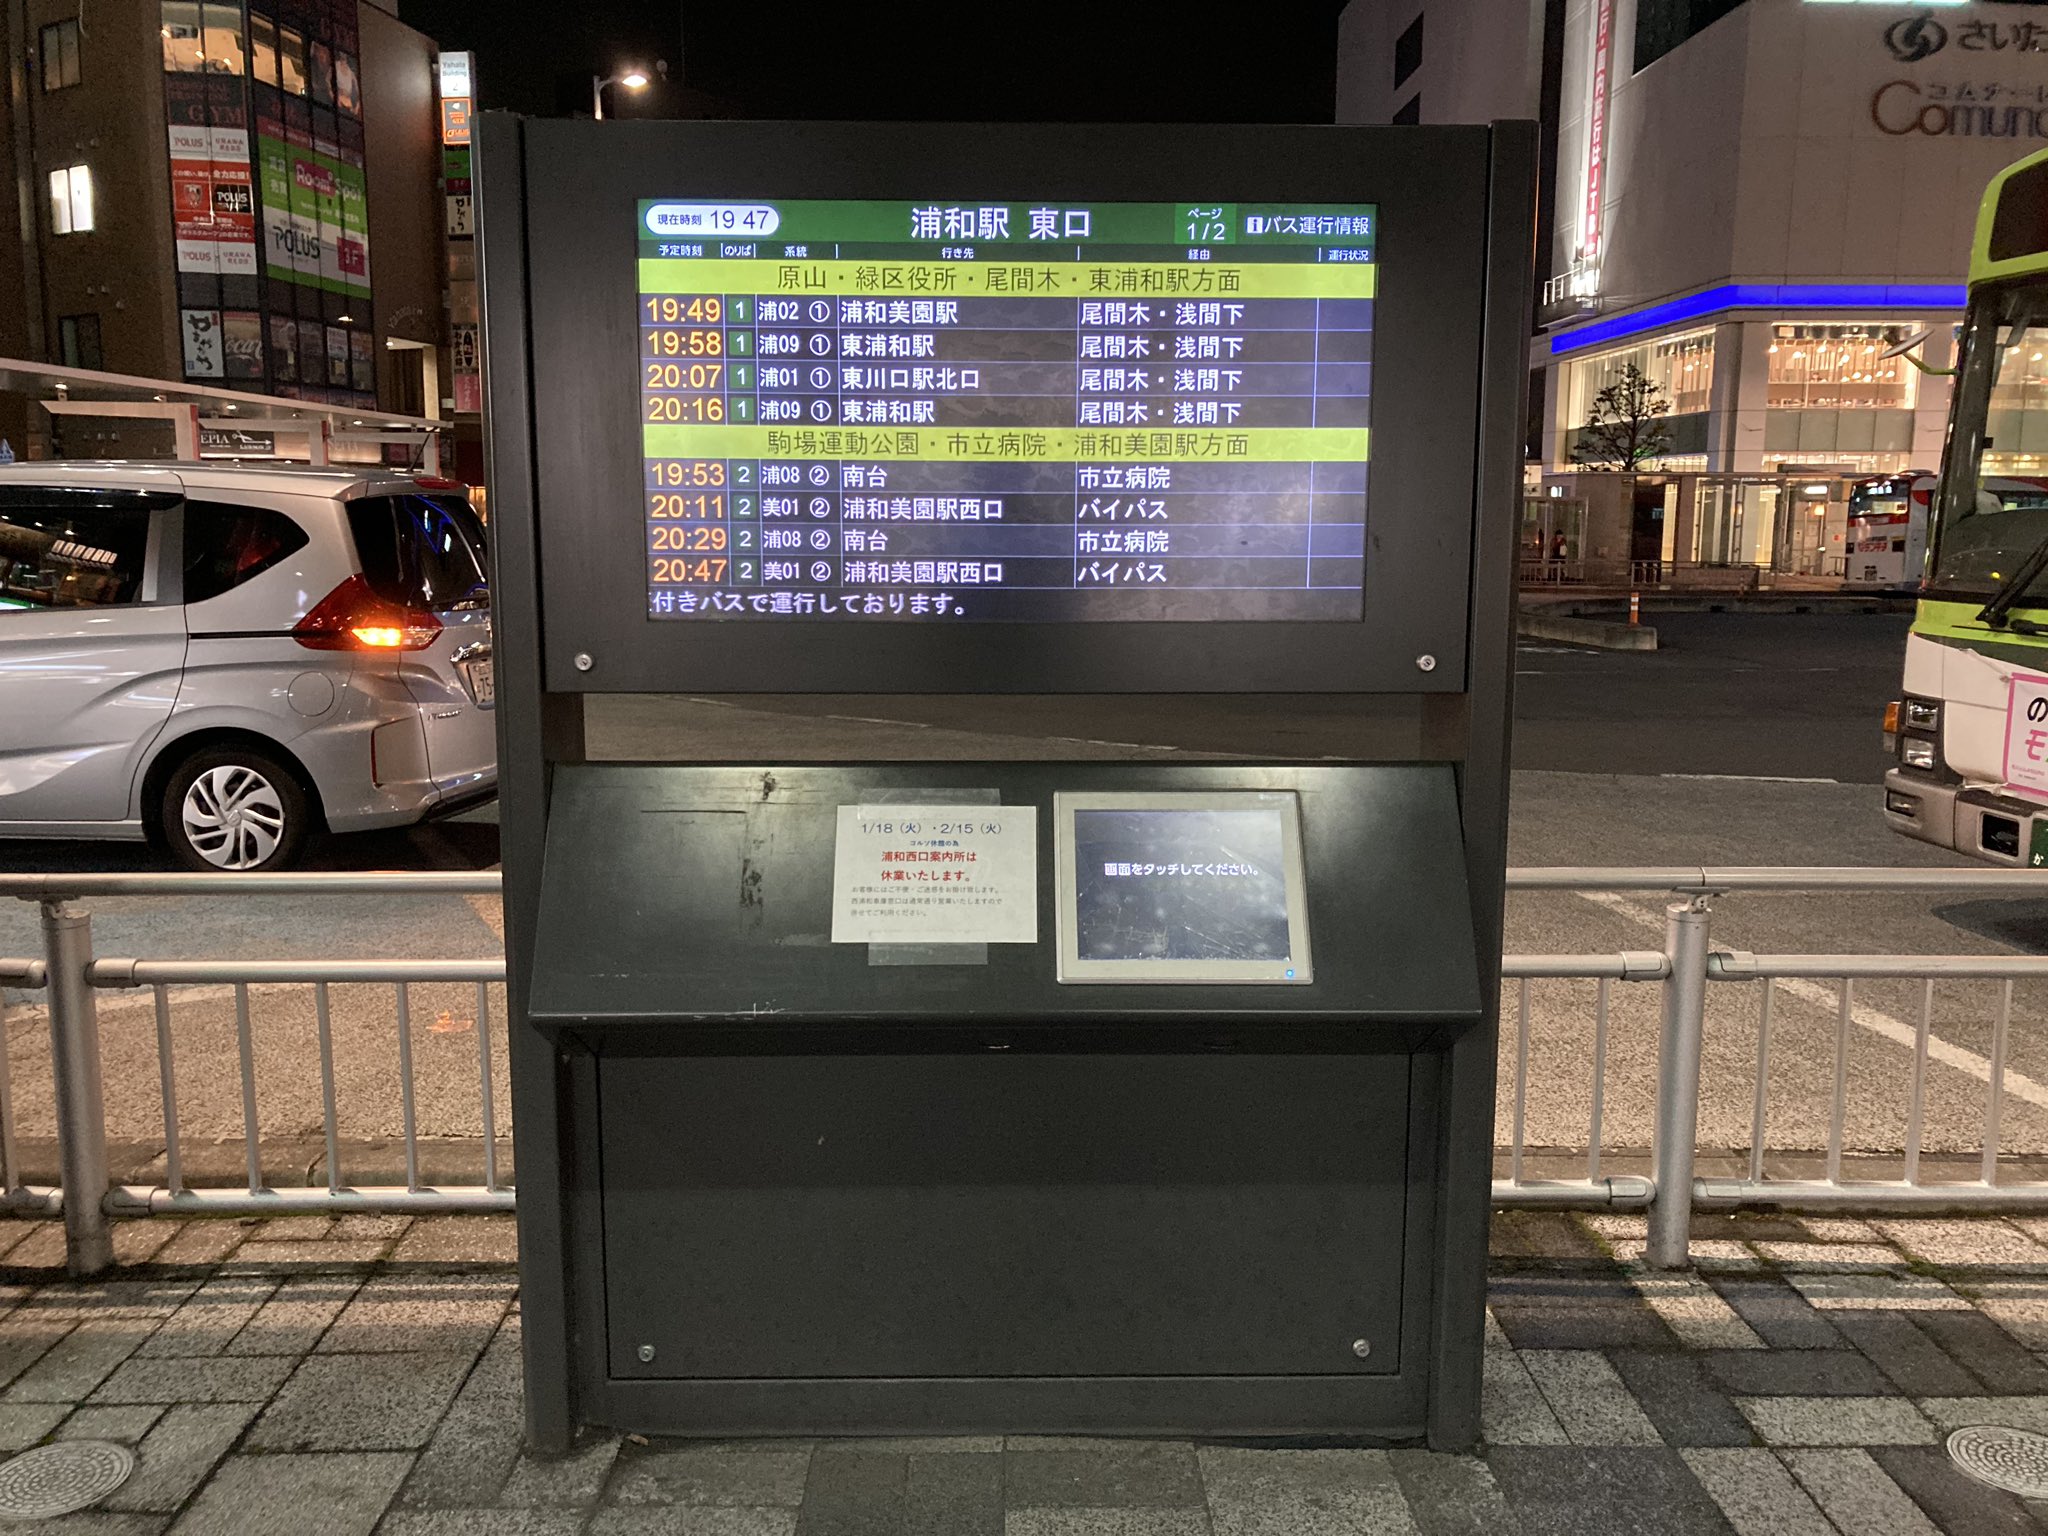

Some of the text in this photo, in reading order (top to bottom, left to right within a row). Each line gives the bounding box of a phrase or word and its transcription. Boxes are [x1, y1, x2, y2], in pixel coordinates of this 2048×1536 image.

[174, 136, 204, 147] POLUS
[216, 191, 248, 203] POLUS
[657, 209, 769, 230] 現在時刻 19 47
[910, 206, 1092, 240] 浦和駅 東口
[1187, 208, 1223, 220] ページ
[1263, 215, 1370, 235] バス運行情報
[272, 225, 321, 259] POLUS
[1187, 223, 1225, 240] 1/2
[658, 244, 1370, 261] 予定時刻 のりば 系統 行き先 経由 運行状況
[776, 265, 1242, 293] 原山・緑区役所・尾間木・東浦和駅方面
[647, 298, 722, 323] 19:49
[736, 302, 745, 319] 1
[759, 300, 800, 321] 浦02
[840, 300, 959, 325] 浦和美園駅
[1080, 302, 1245, 326] 尾間木・浅間下
[647, 331, 722, 356] 19:58
[736, 335, 746, 353] 1
[759, 334, 800, 355] 浦09
[841, 333, 935, 358] 東浦和駅
[1080, 335, 1244, 359] 尾間木・浅間下
[647, 364, 723, 389] 20:07
[737, 368, 746, 387] 1
[760, 366, 800, 388] 浦01
[841, 367, 981, 391] 東川口駅北口
[1079, 367, 1243, 392] 尾間木・浅間下
[648, 397, 723, 422] 20:16
[737, 401, 747, 419] 1
[760, 400, 801, 422] 浦09
[842, 399, 936, 424] 東浦和駅
[1079, 401, 1242, 425] 尾間木・浅間下
[767, 430, 1250, 457] 駒場運動公園・市立病院・浦和美園駅方面
[652, 462, 725, 487] 19:53
[738, 466, 750, 483] 2
[762, 465, 800, 486] 浦08
[843, 464, 889, 488] 南台
[1077, 465, 1171, 490] 市立病院
[651, 495, 724, 519] 20:11
[738, 499, 751, 516] 2
[762, 497, 800, 518] 美01
[843, 498, 1003, 521] 浦和美園駅西口
[1078, 498, 1169, 521] バイパス
[651, 527, 727, 551] 20:29
[739, 531, 752, 548] 2
[763, 529, 801, 550] 浦08
[844, 529, 889, 552] 南台
[1077, 529, 1170, 553] 市立病院
[652, 559, 728, 583] 20:47
[740, 563, 753, 579] 2
[764, 562, 800, 582] 美01
[844, 562, 1003, 584] 浦和美園駅西口
[1077, 562, 1168, 584] バイパス
[650, 591, 966, 616] 付きバスで運行しております。
[881, 851, 977, 863] 浦和西口案内所は
[1104, 863, 1259, 876] 画面をタッチしてください。
[881, 870, 971, 882] 休業いたします。
